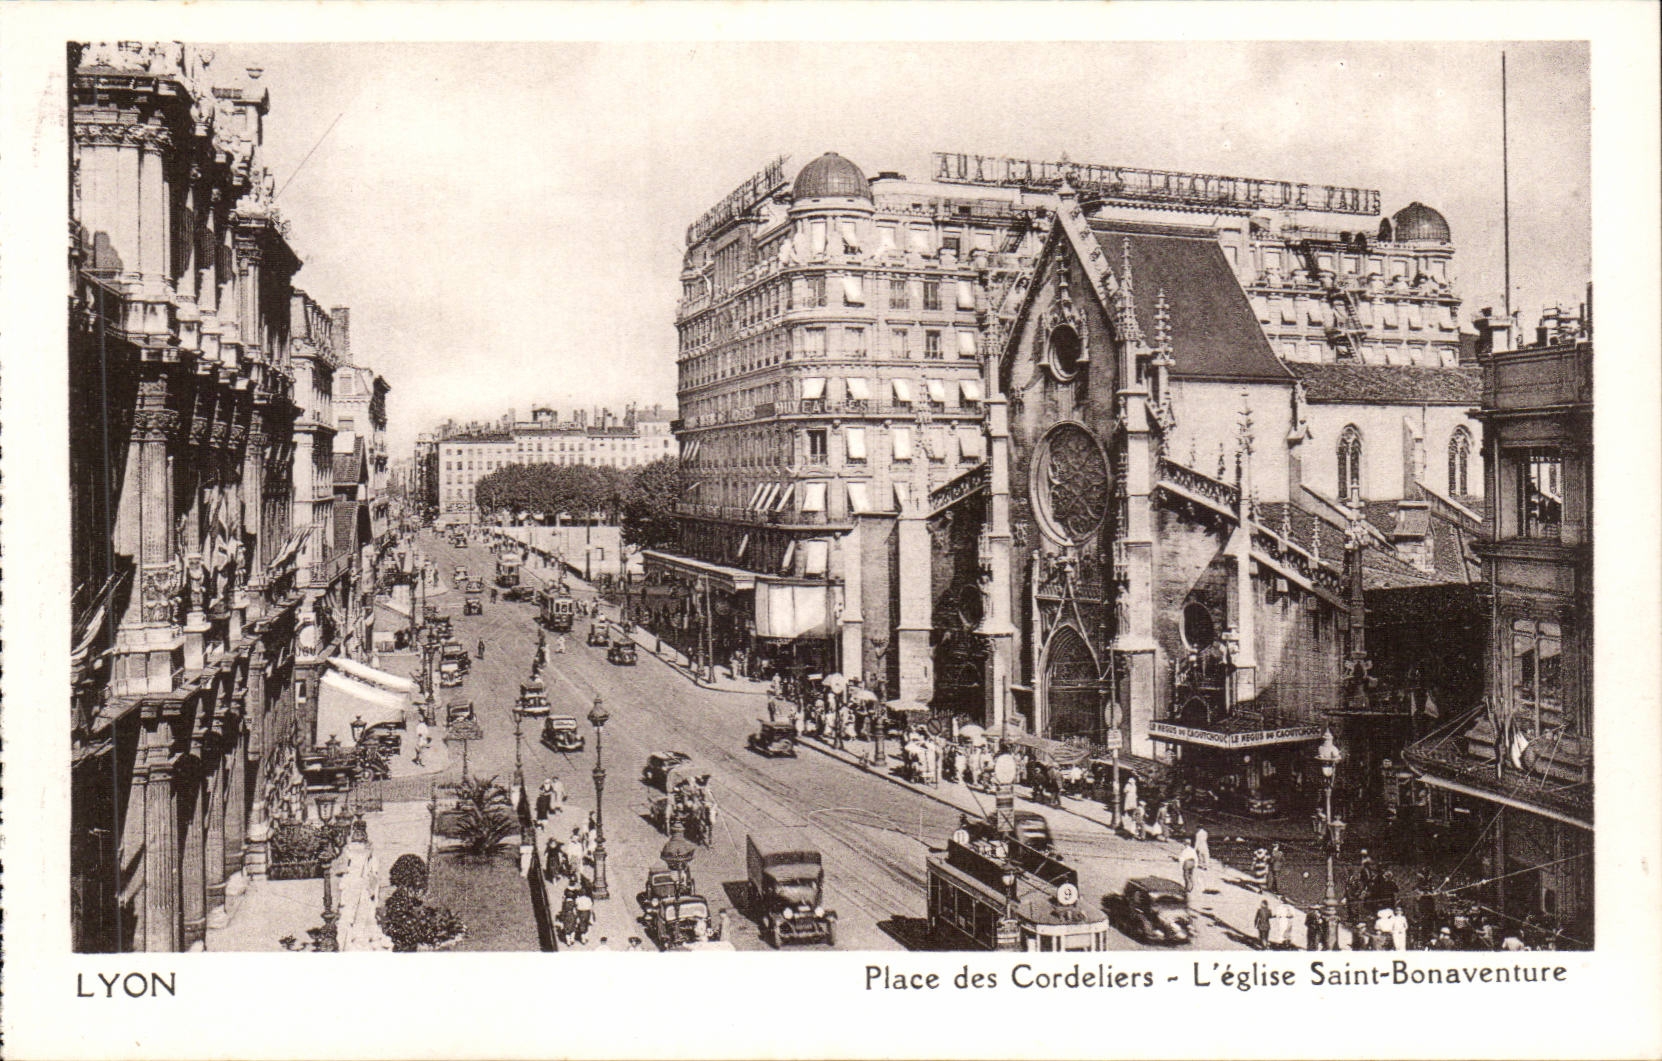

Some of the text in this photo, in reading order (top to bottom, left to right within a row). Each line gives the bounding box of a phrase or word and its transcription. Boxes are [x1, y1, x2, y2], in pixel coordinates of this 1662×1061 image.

[937, 153, 1381, 215] AUX GALIES LAFAYETTE DE PARIS
[1231, 734, 1240, 744] LE
